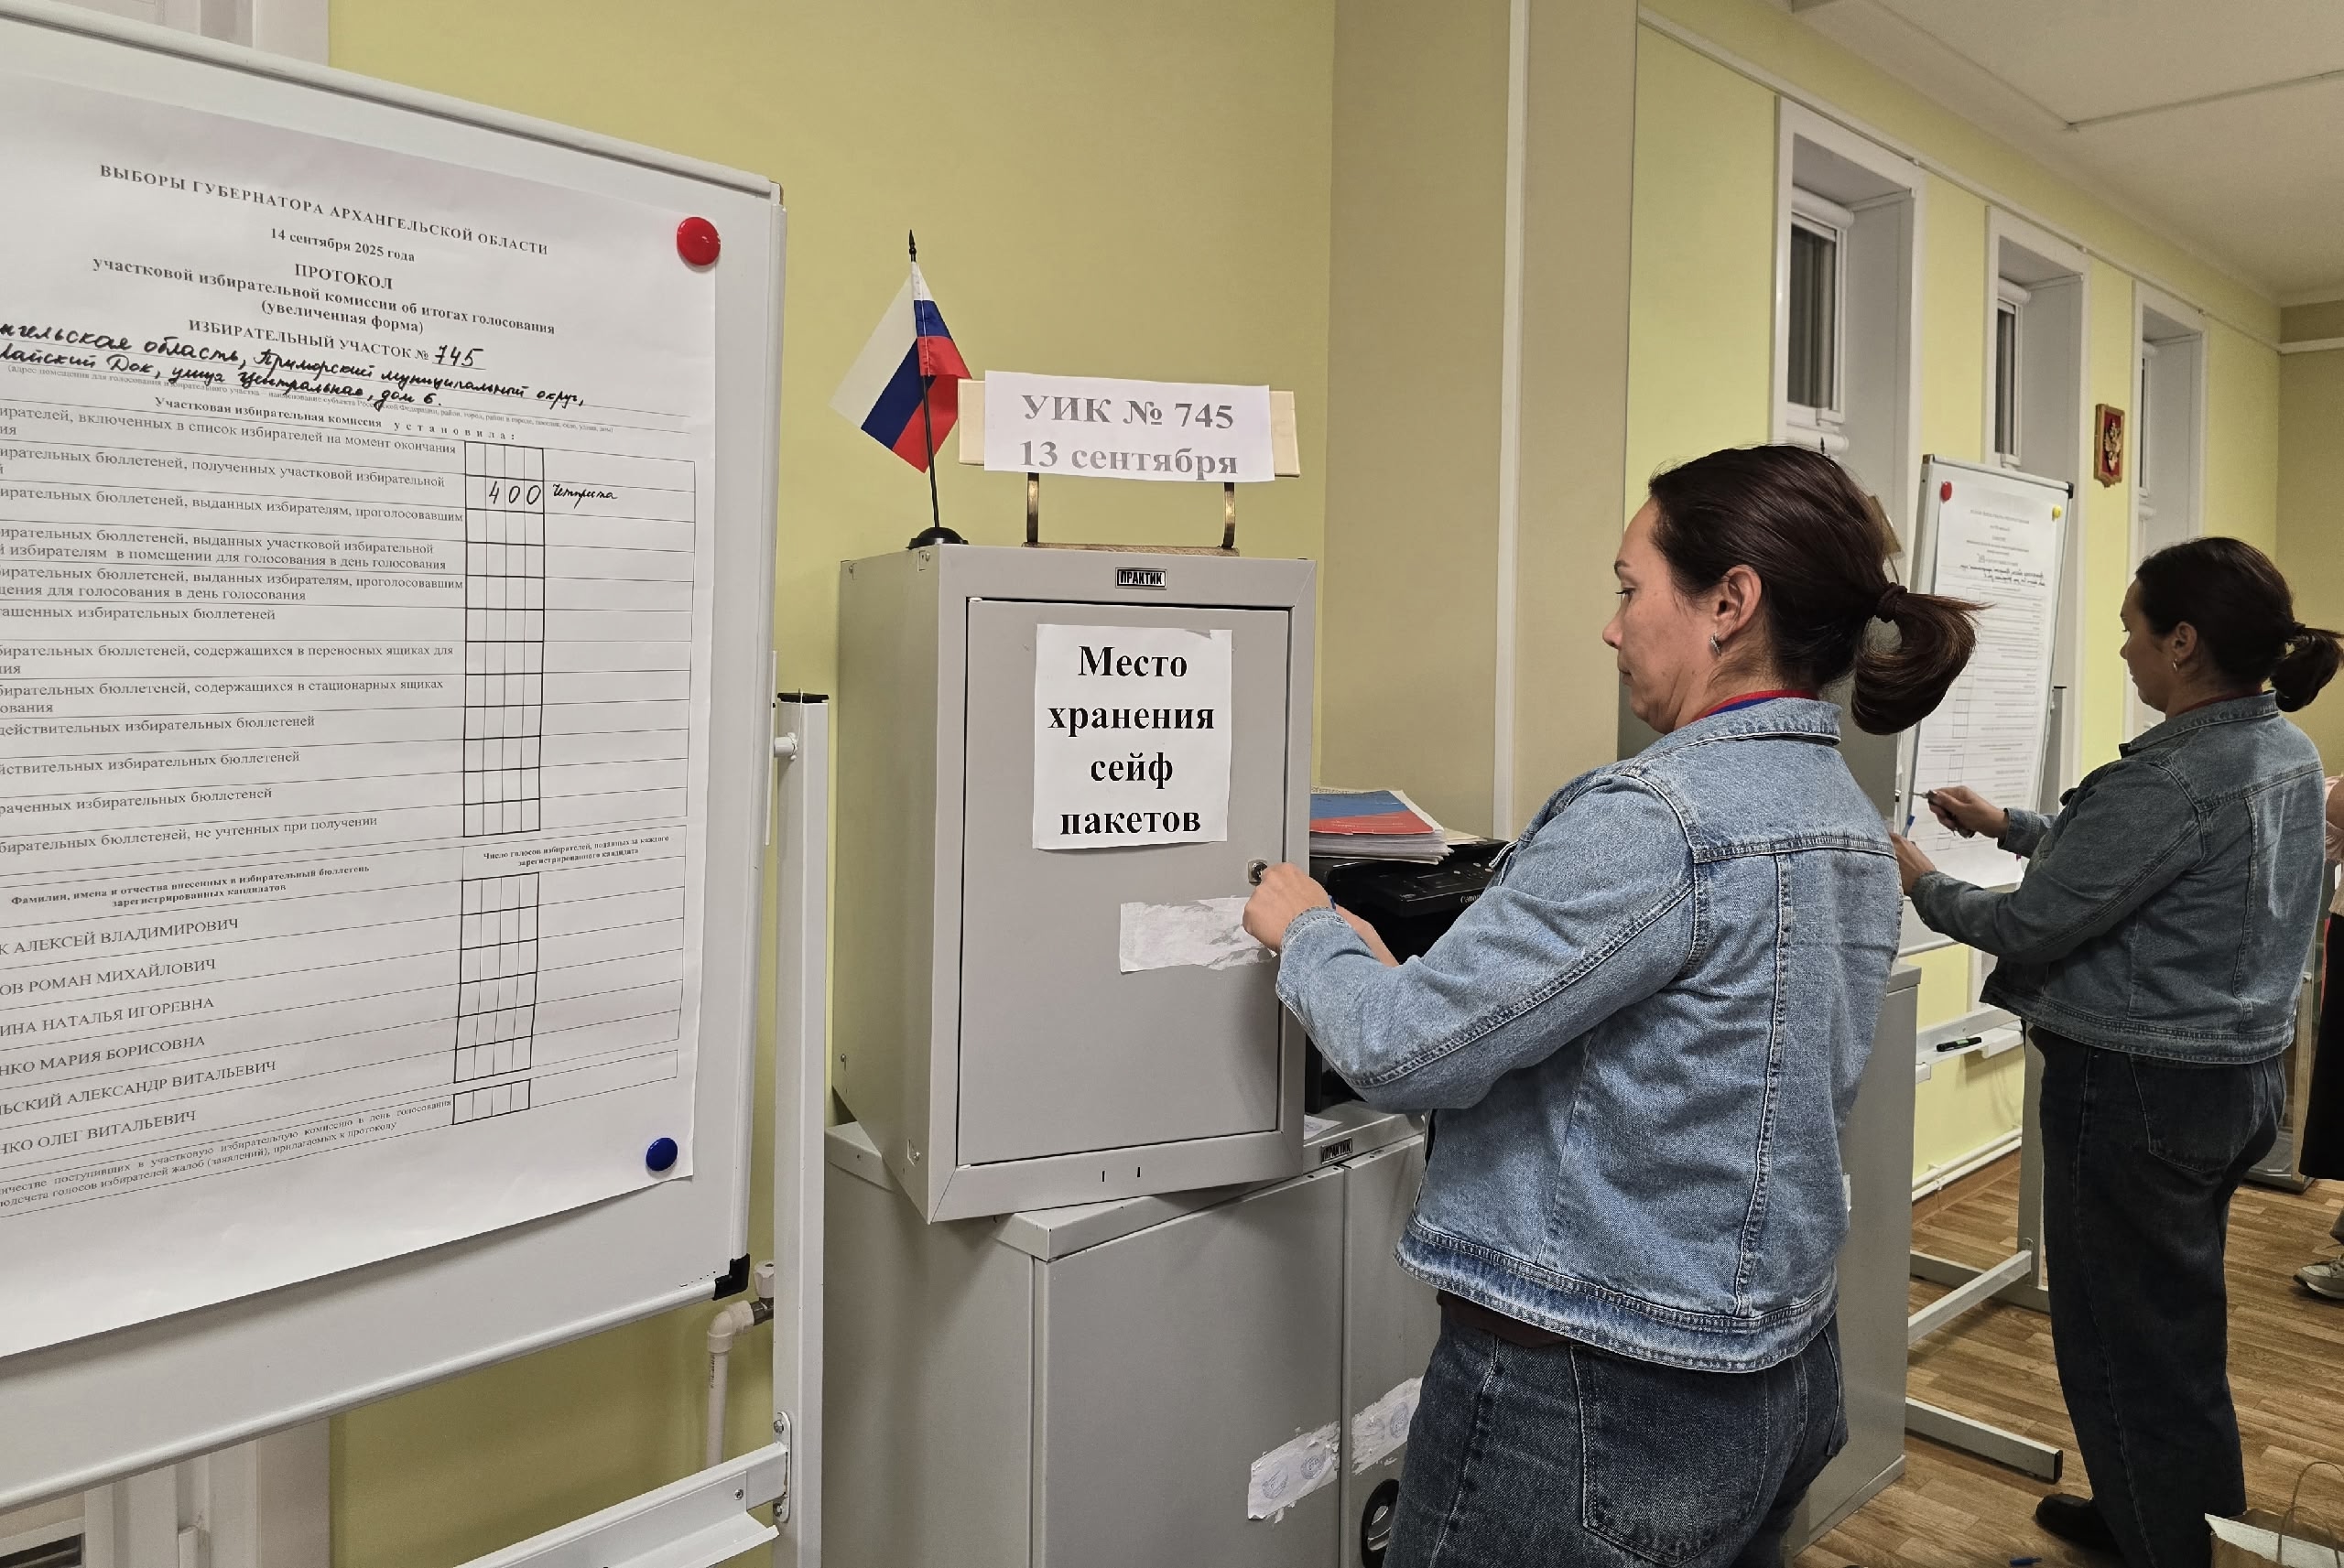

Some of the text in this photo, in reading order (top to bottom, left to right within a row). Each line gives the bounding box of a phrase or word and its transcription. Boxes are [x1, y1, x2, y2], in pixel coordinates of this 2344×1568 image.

[102, 165, 547, 254] ВЫБОРЫ ГУБЕРНАТОРА АРХАНГЕЛЬСКОЙ ОБЛАСТИ
[273, 228, 414, 262] 14 сентября 2025 года
[296, 264, 392, 289] ПРОТОКОЛ
[93, 258, 554, 334] участковой избирательной комиссии об итогах голосования
[262, 300, 423, 334] (увеличенная форма)
[190, 320, 429, 360] ИЗБИРАТЕЛЬНЫЙ УЧАСТОК №
[434, 345, 483, 367] 745
[156, 396, 381, 427] Участковая избирательная комиссия
[1021, 395, 1233, 428] УИК № 745
[79, 414, 172, 429] включенных
[178, 422, 184, 430] в
[190, 423, 236, 436] список
[242, 426, 322, 443] избирателей
[327, 435, 341, 444] на
[346, 437, 391, 448] момент
[395, 441, 455, 454] окончания
[96, 451, 187, 470] бюллетеней,
[193, 461, 276, 475] полученных
[280, 468, 352, 481] участковой
[357, 471, 444, 487] избирательной
[1020, 440, 1239, 481] 13 сентября
[1, 488, 462, 522] ирательных бюллетеней, выданных избирателям, проголосовавшим
[489, 481, 542, 504] 400
[11, 544, 106, 558] избирателям
[117, 550, 124, 559] в
[129, 551, 211, 562] помещении
[216, 554, 239, 563] для
[244, 555, 325, 566] голосования
[331, 557, 336, 566] в
[341, 558, 369, 568] день
[373, 559, 445, 569] голосования
[97, 529, 433, 555] бюллетеней, выданных участковой избирательной
[48, 587, 73, 597] для
[80, 588, 169, 598] голосования
[187, 590, 218, 600] день
[223, 590, 305, 600] голосования
[97, 568, 462, 589] бюллетеней, выданных избирателям, проголосовавшим
[1120, 570, 1163, 586] ПРАКТИК
[79, 607, 275, 621] избирательных бюллетеней
[99, 644, 452, 659] бюллетеней, содержащихся в переносных ящиках для
[1078, 645, 1188, 677] Место
[100, 681, 443, 696] бюллетеней, содержащихся в стационарных ящиках
[125, 715, 314, 734] избирательных бюллетеней
[1047, 707, 1215, 738] хранения
[108, 752, 299, 771] избирательных бюллетеней
[1091, 752, 1174, 789] сейф
[77, 788, 271, 811] избирательных бюллетеней
[102, 828, 190, 845] бюллетеней,
[196, 830, 211, 838] не
[216, 825, 279, 840] учтенных
[284, 823, 307, 835] при
[311, 817, 376, 831] получении
[1059, 811, 1201, 835] пакетов
[14, 918, 237, 953] АЛЕКСЕЙ ВЛАДИМИРОВИЧ
[0, 959, 215, 996] ОВ РОМАН МИХАЙЛОВИЧ
[43, 998, 214, 1031] НАТАЛЬЯ ИГОРЕВНА
[41, 1036, 204, 1070] МАРИЯ БОРИСОВНА
[67, 1061, 276, 1104] АЛЕКСАНДР ВИТАЛЬЕВИЧ
[38, 1110, 195, 1148] ОЛЕГ ВИТАЛЬЕВИЧ
